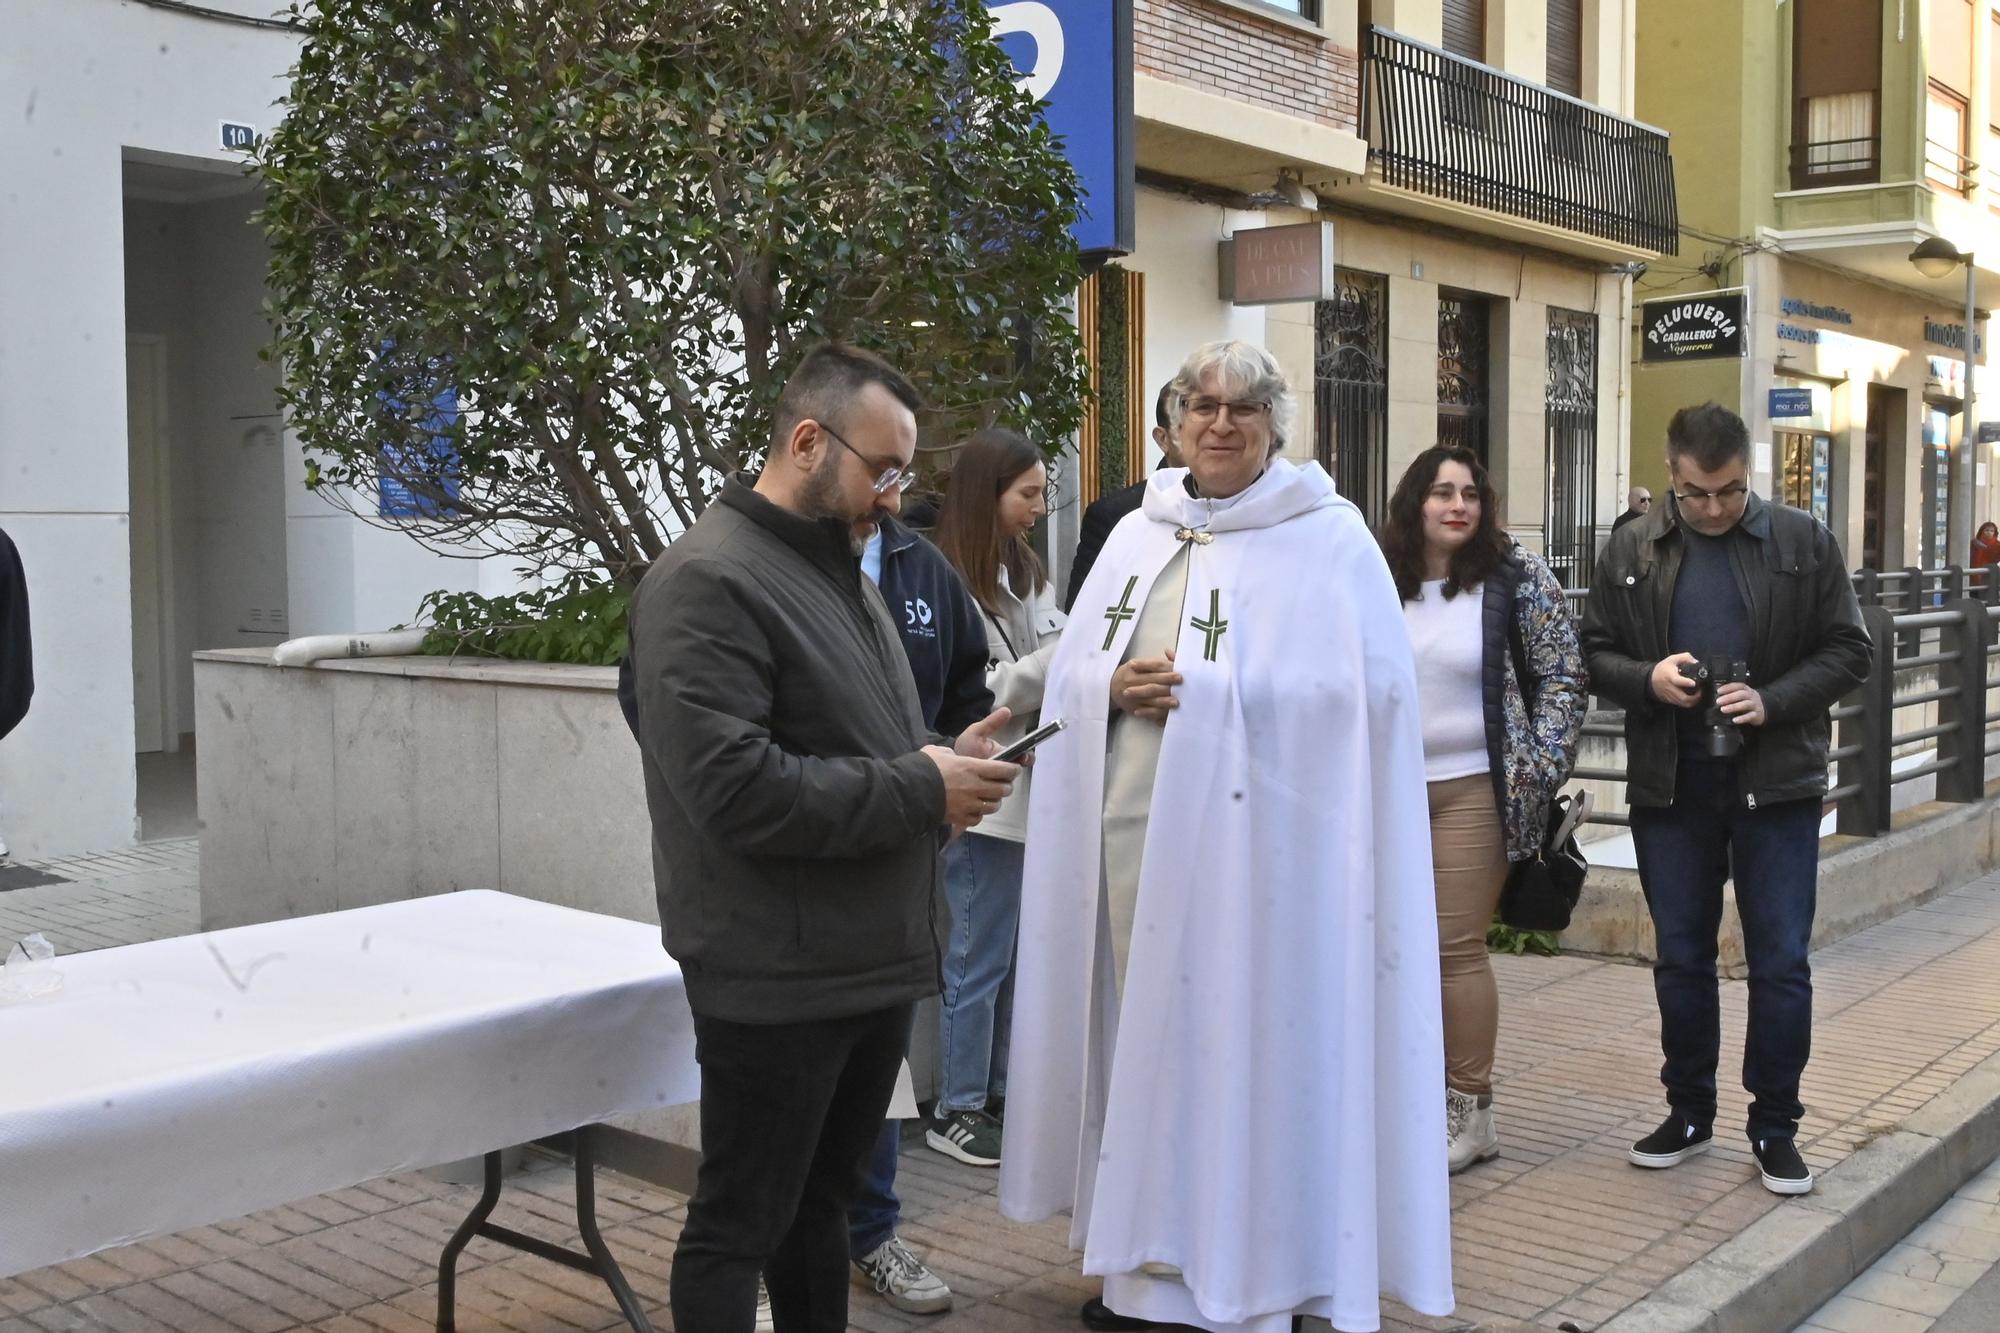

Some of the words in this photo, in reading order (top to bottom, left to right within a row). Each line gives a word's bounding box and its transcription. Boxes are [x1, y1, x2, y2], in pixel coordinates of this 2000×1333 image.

[229, 127, 246, 146] 10
[1247, 240, 1269, 261] DE
[1647, 303, 1737, 344] PELUQUERIA
[1662, 329, 1718, 343] CABALLEROS
[1663, 342, 1714, 355] Nogueras
